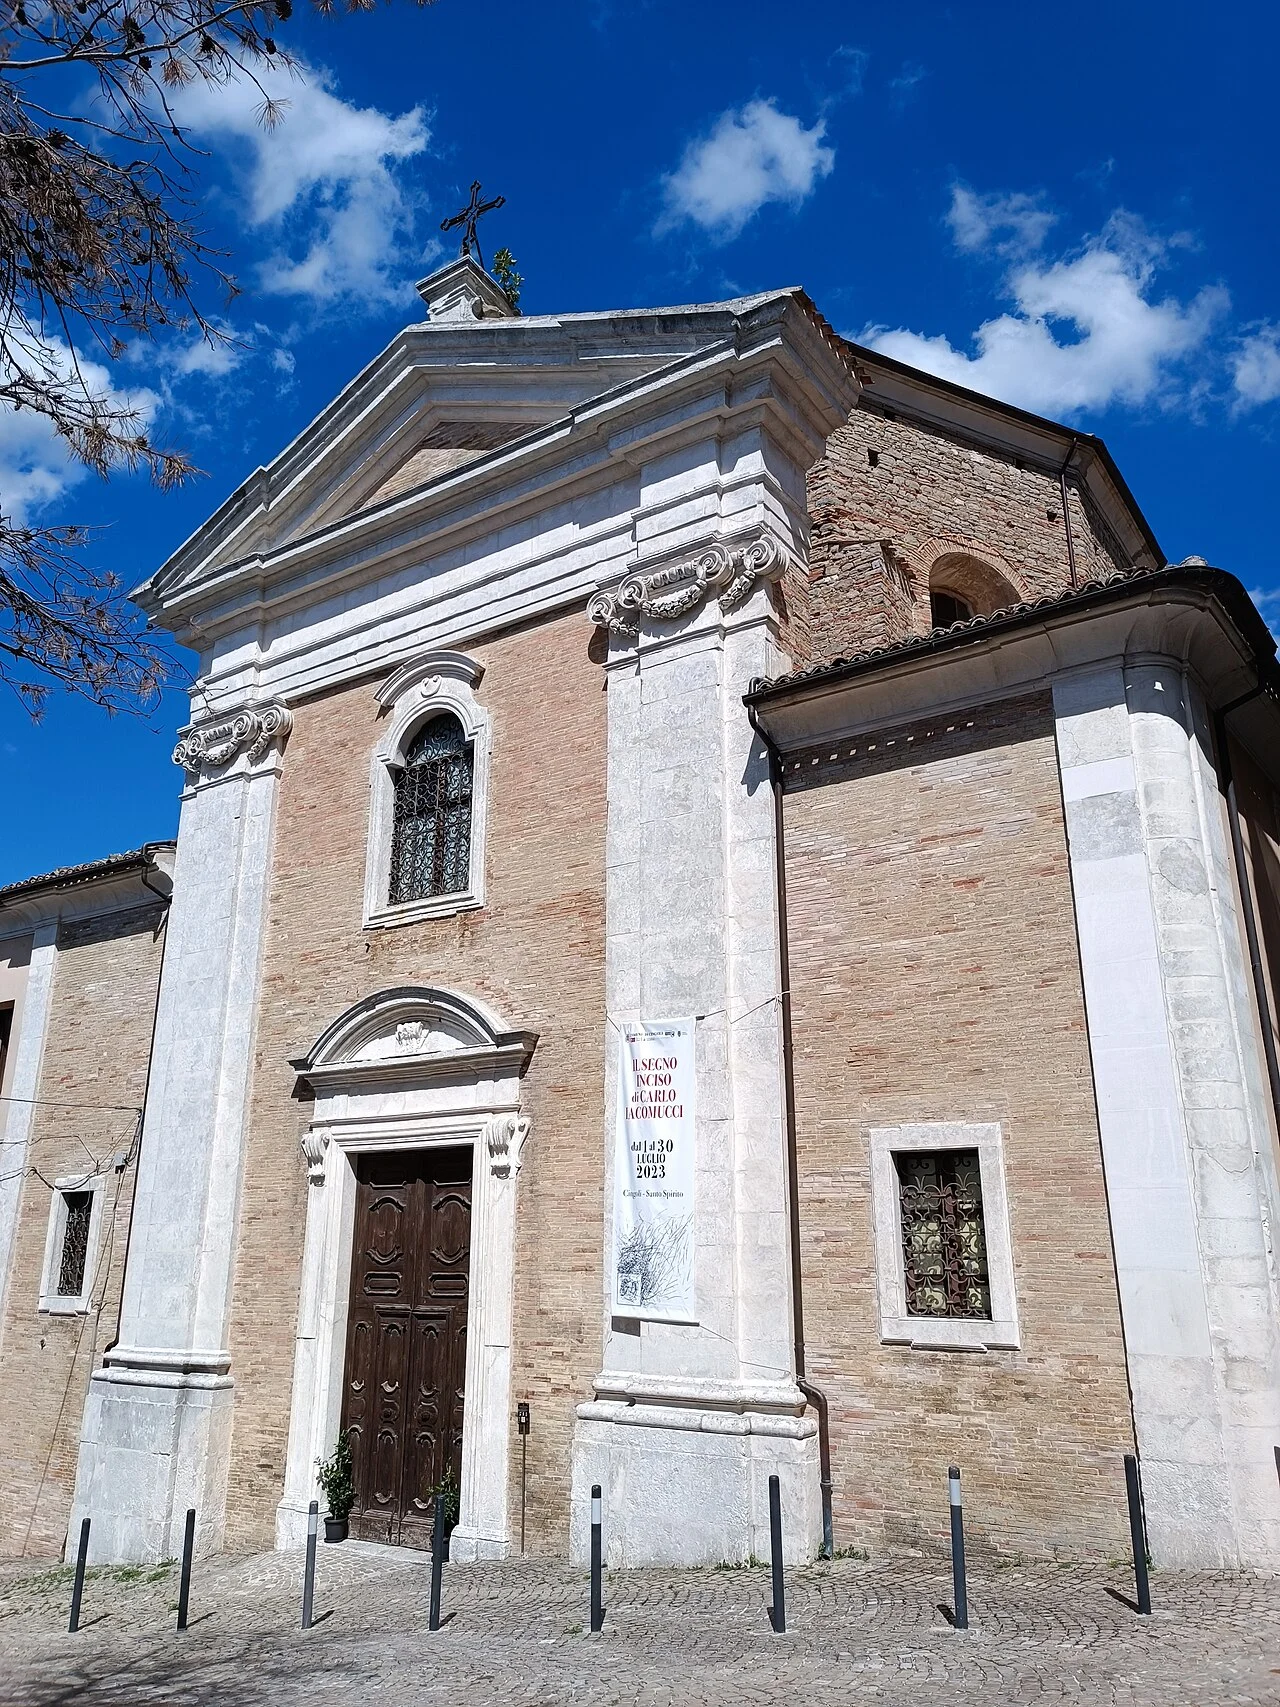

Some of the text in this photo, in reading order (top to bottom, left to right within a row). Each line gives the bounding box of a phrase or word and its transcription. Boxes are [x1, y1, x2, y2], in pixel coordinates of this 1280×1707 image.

[632, 1057, 677, 1072] IL SEGNO
[636, 1073, 672, 1087] INCISO
[631, 1089, 676, 1103] di CARLO
[625, 1104, 683, 1119] IACOMUCCI
[630, 1141, 641, 1152] dal
[657, 1139, 674, 1153] 30
[637, 1153, 666, 1164] LUGLIO
[636, 1164, 666, 1179] 2023
[645, 1189, 662, 1198] Santo
[662, 1189, 684, 1200] Spirito
